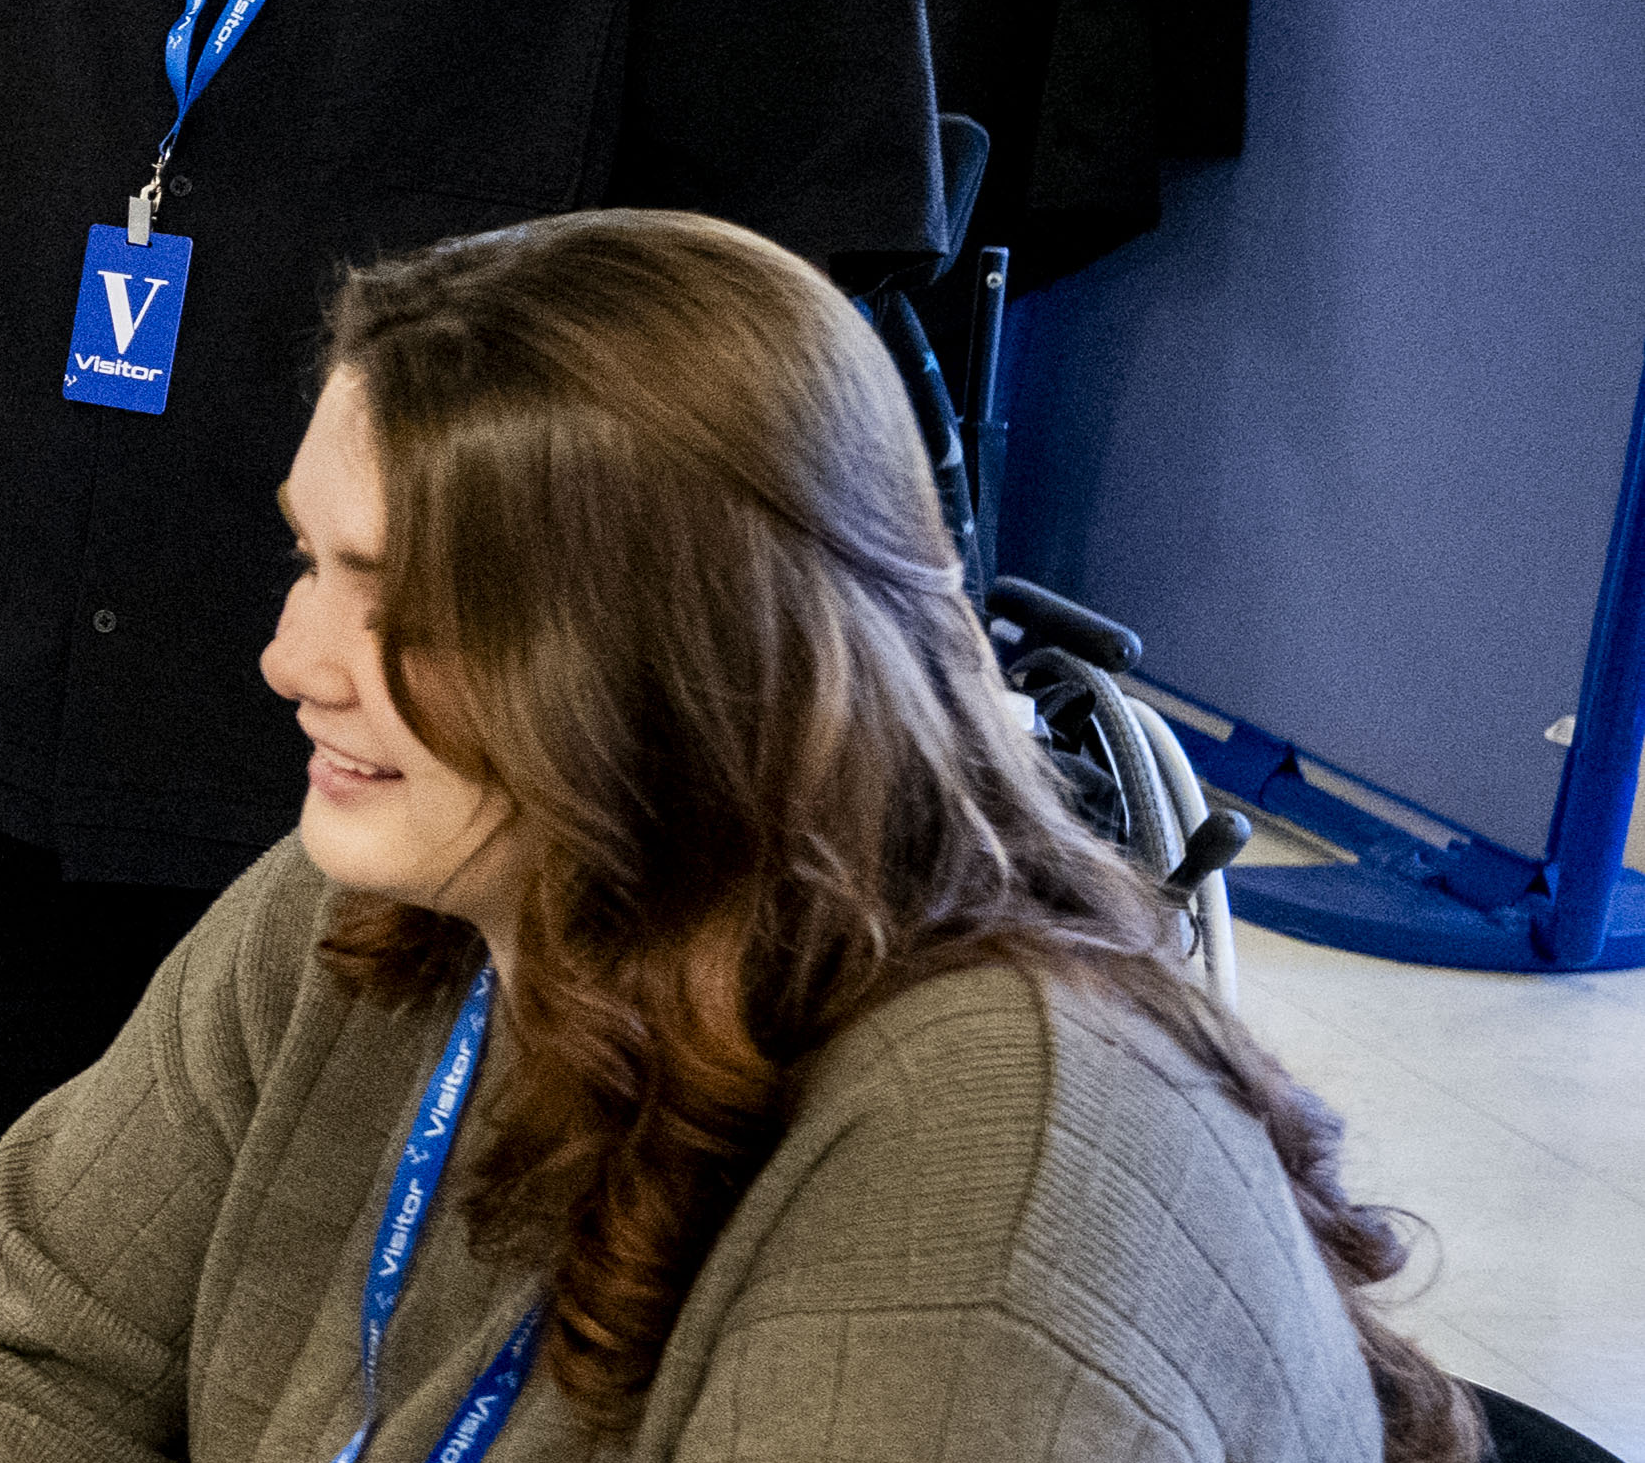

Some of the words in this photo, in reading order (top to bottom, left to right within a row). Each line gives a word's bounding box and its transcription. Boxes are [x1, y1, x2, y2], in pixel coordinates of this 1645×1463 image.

[97, 270, 169, 355] V
[75, 353, 163, 381] Visitor
[423, 1038, 471, 1136] Visitor
[378, 1177, 424, 1276] Visitor
